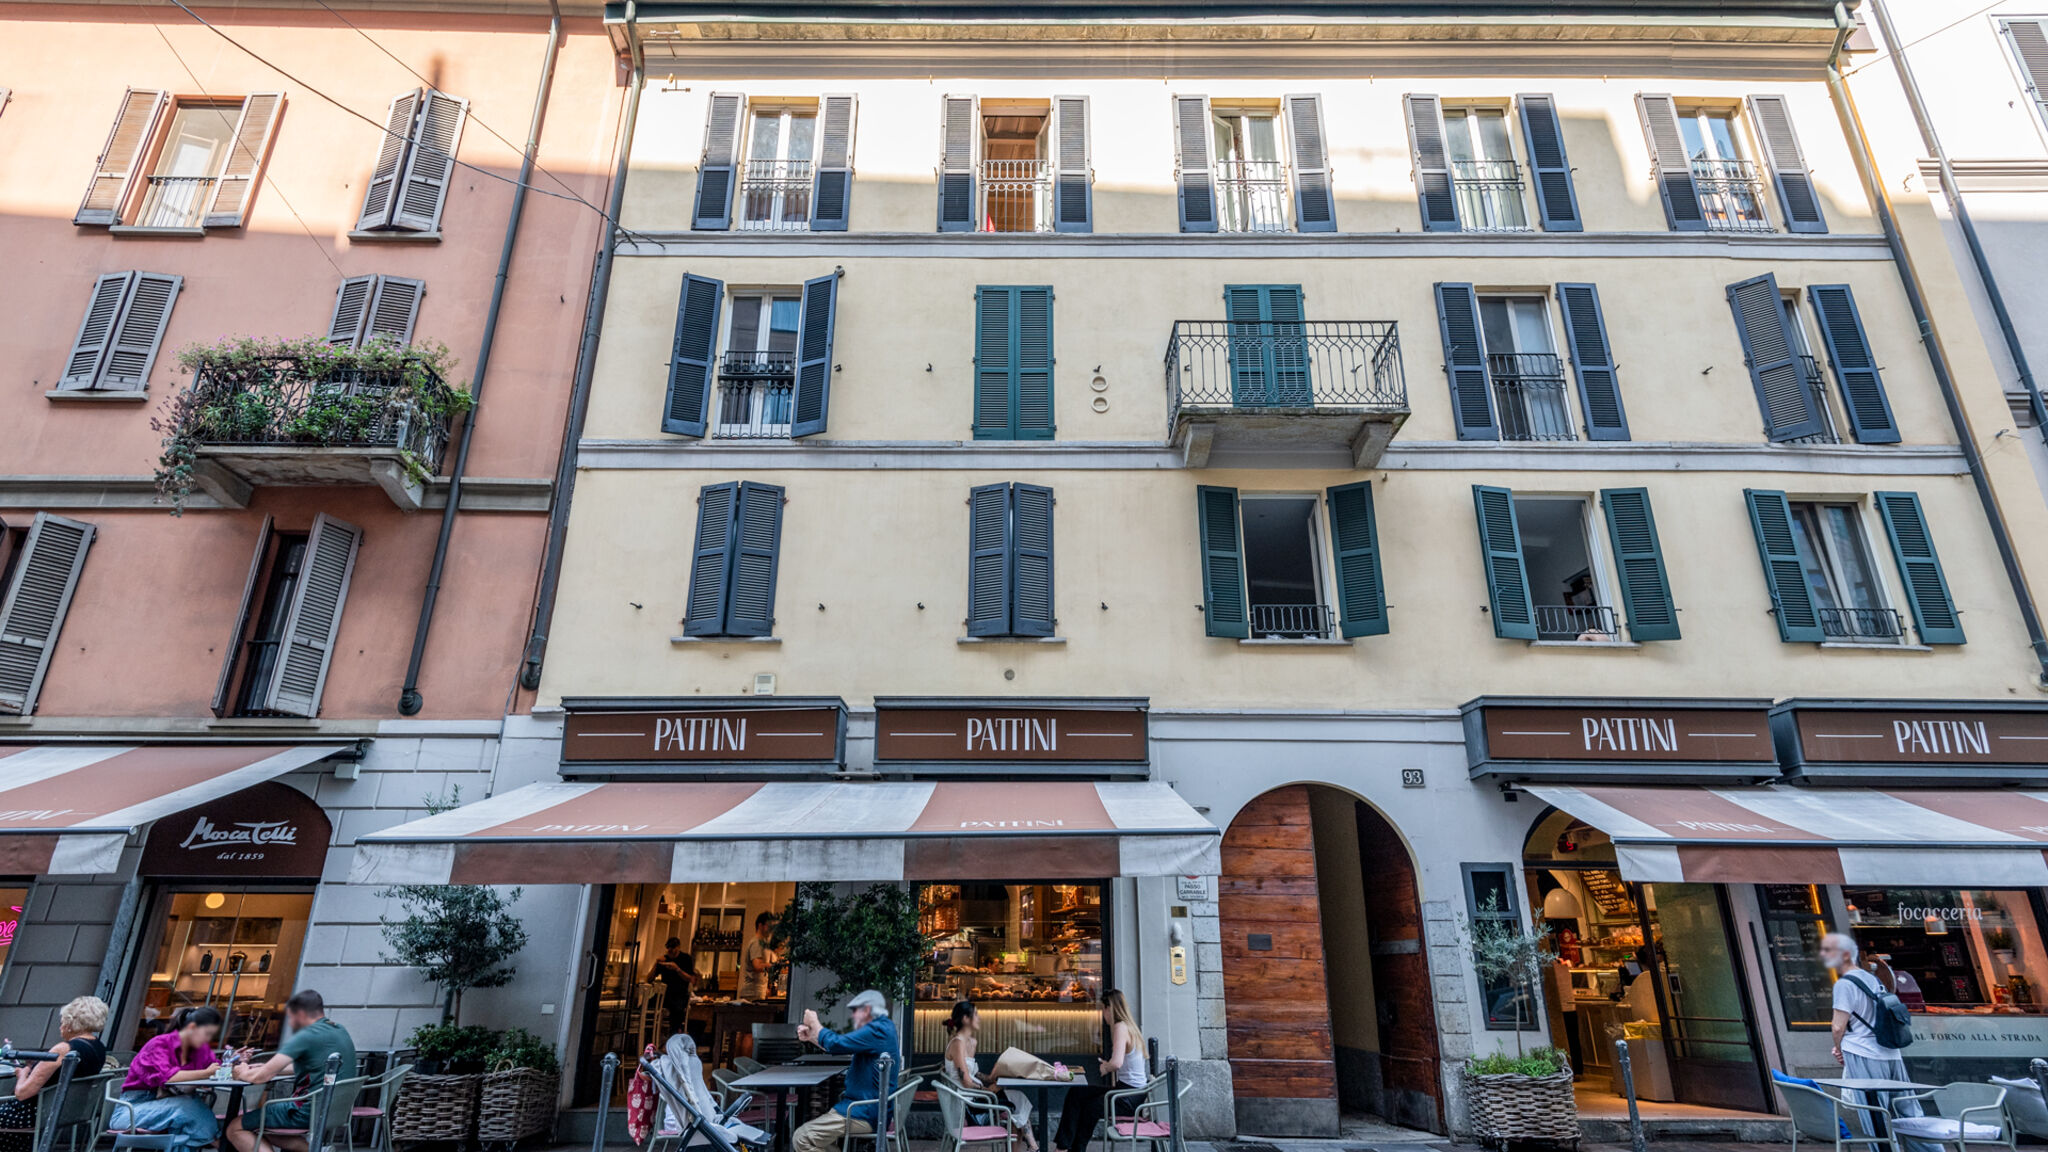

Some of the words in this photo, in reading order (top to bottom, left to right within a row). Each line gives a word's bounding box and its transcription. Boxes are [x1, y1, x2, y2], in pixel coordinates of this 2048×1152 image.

[654, 718, 747, 751] PATTINI
[966, 718, 1057, 751] PATTINI
[1582, 717, 1678, 751] PATTINI
[1893, 720, 1991, 754] PATTINI
[1403, 770, 1422, 784] 93
[959, 819, 1064, 828] PATTINI
[217, 852, 236, 860] dal
[1897, 901, 1983, 925] focacceria
[1930, 1032, 1966, 1041] FORNO
[1970, 1033, 1997, 1041] ALLA
[2000, 1034, 2042, 1042] STRADA
